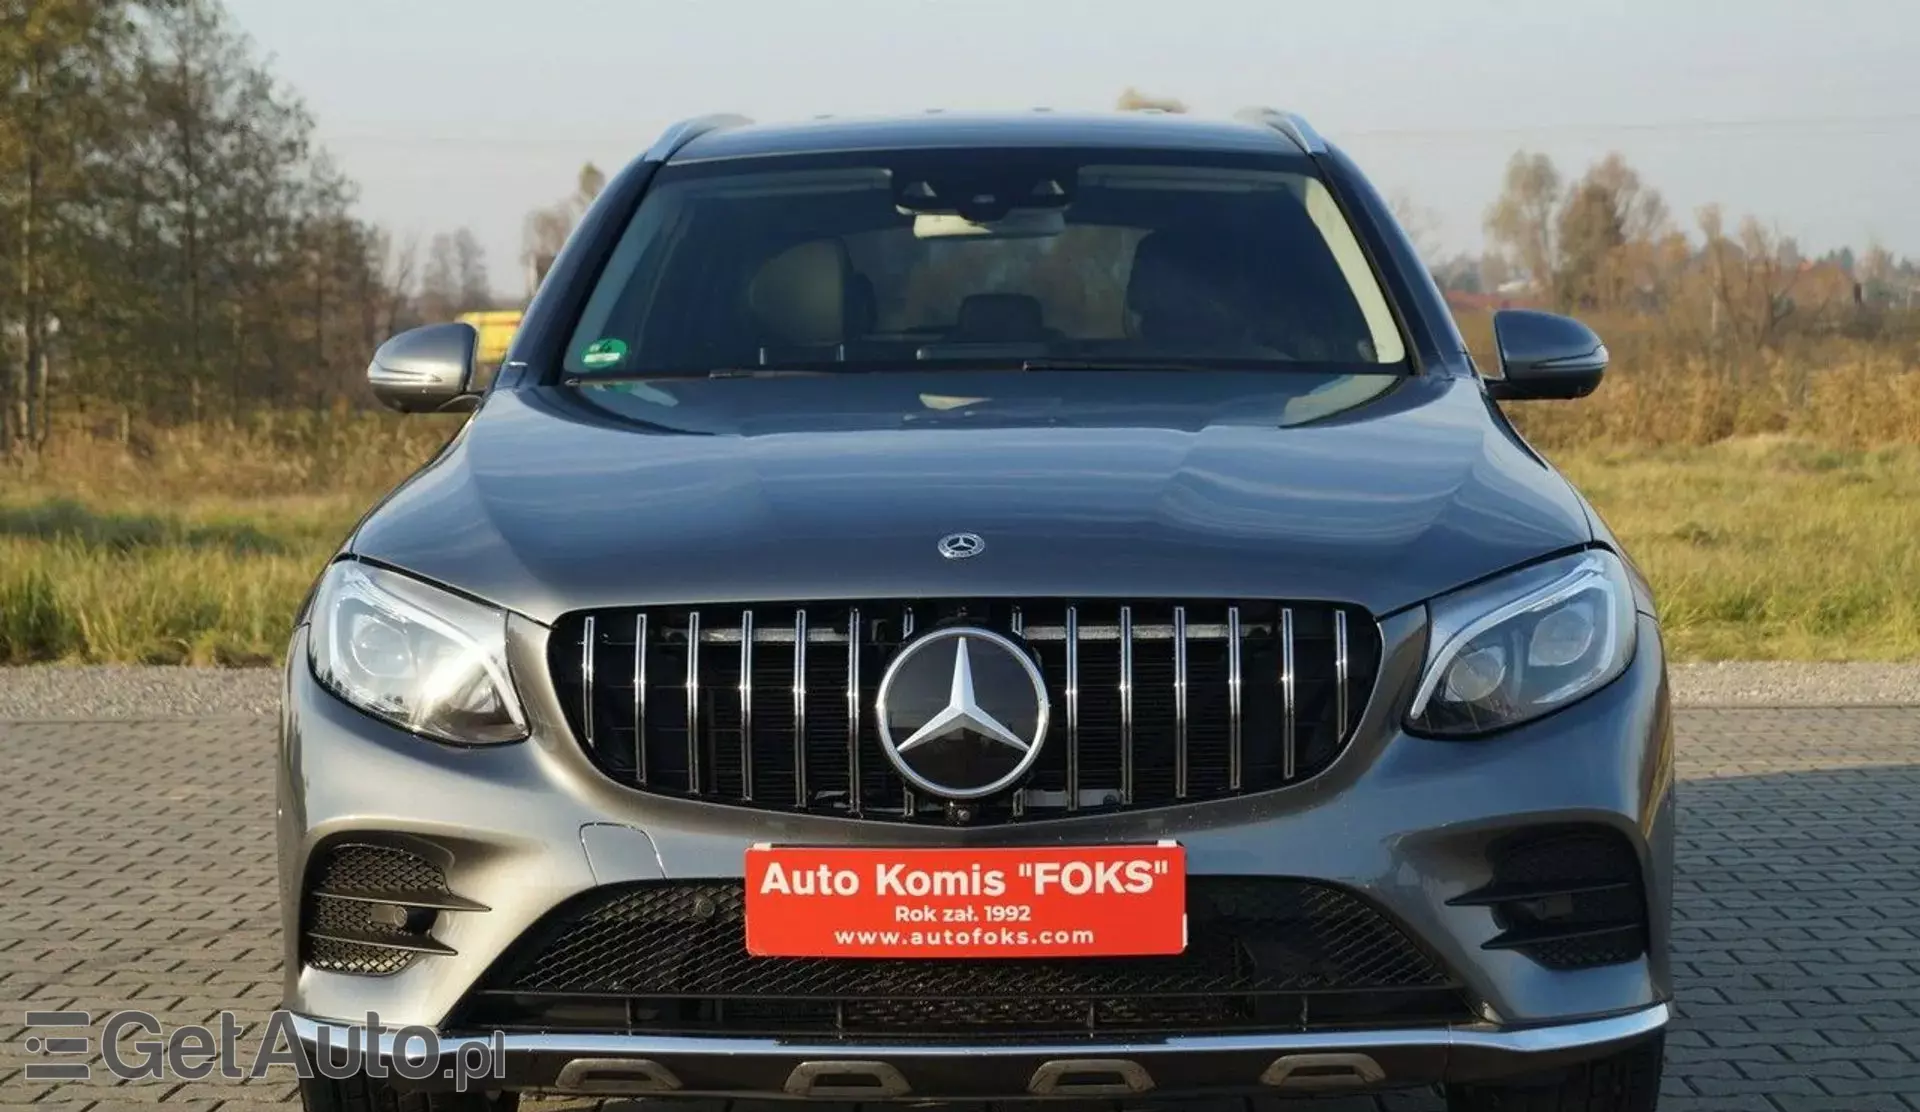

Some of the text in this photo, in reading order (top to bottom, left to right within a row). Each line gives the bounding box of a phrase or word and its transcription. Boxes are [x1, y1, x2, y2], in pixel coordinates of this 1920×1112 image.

[760, 860, 1169, 897] Auto Komis "FOKS"
[895, 905, 1032, 923] Rok zał. 1992
[834, 927, 1094, 946] www.autofoks.com
